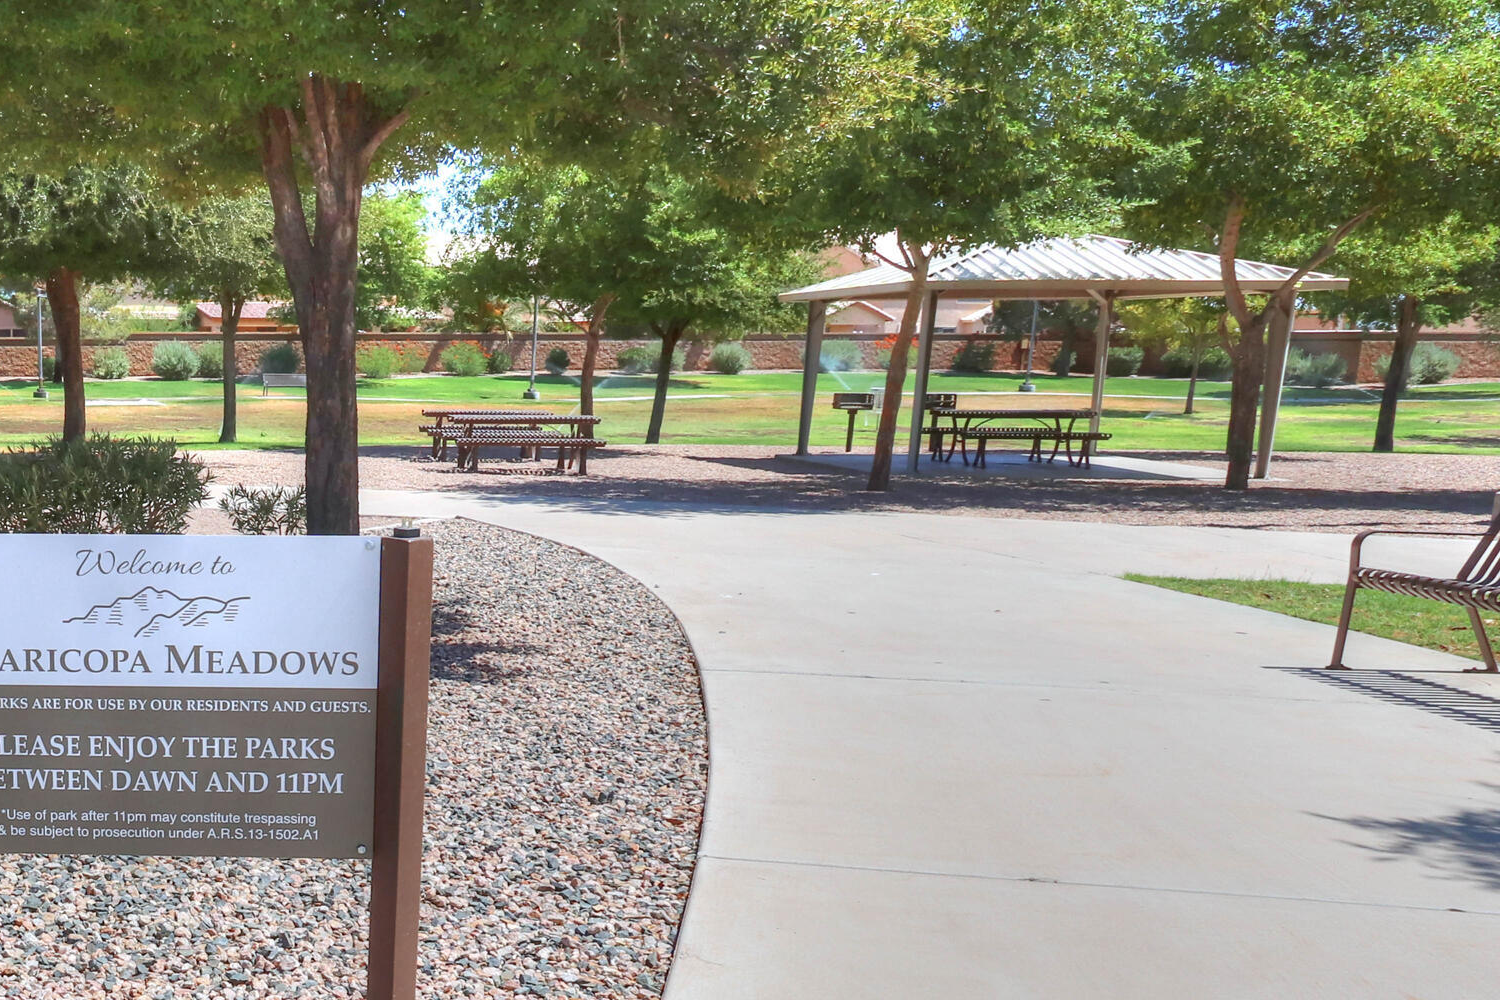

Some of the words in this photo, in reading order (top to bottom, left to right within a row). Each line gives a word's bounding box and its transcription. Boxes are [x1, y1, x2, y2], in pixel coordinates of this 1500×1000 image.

[75, 548, 204, 577] Welcome
[210, 555, 237, 575] to
[31, 697, 62, 710] ARE
[63, 698, 94, 710] FOR
[97, 698, 125, 711] USE
[128, 698, 148, 711] BY
[150, 698, 183, 711] OUR
[186, 699, 269, 712] RESIDENTS
[271, 700, 307, 713] AND
[309, 700, 371, 713] GUESTS.
[87, 735, 176, 763] ENJOY
[181, 736, 238, 759] THE
[244, 737, 335, 760] PARKS
[109, 770, 199, 793] DAWN
[204, 771, 269, 793] AND
[276, 772, 344, 794] 11PM
[34, 809, 47, 821] of
[50, 809, 78, 823] park
[80, 809, 110, 822] after
[112, 810, 147, 825] 11pm
[150, 813, 178, 826] may
[180, 811, 241, 824] constitute
[244, 812, 317, 828] trespassing
[10, 824, 27, 836] be
[29, 824, 74, 840] subject
[76, 826, 90, 837] to
[92, 826, 165, 840] prosecution
[168, 827, 205, 839] under
[206, 827, 319, 841] A.R.S.13-1502.A1
